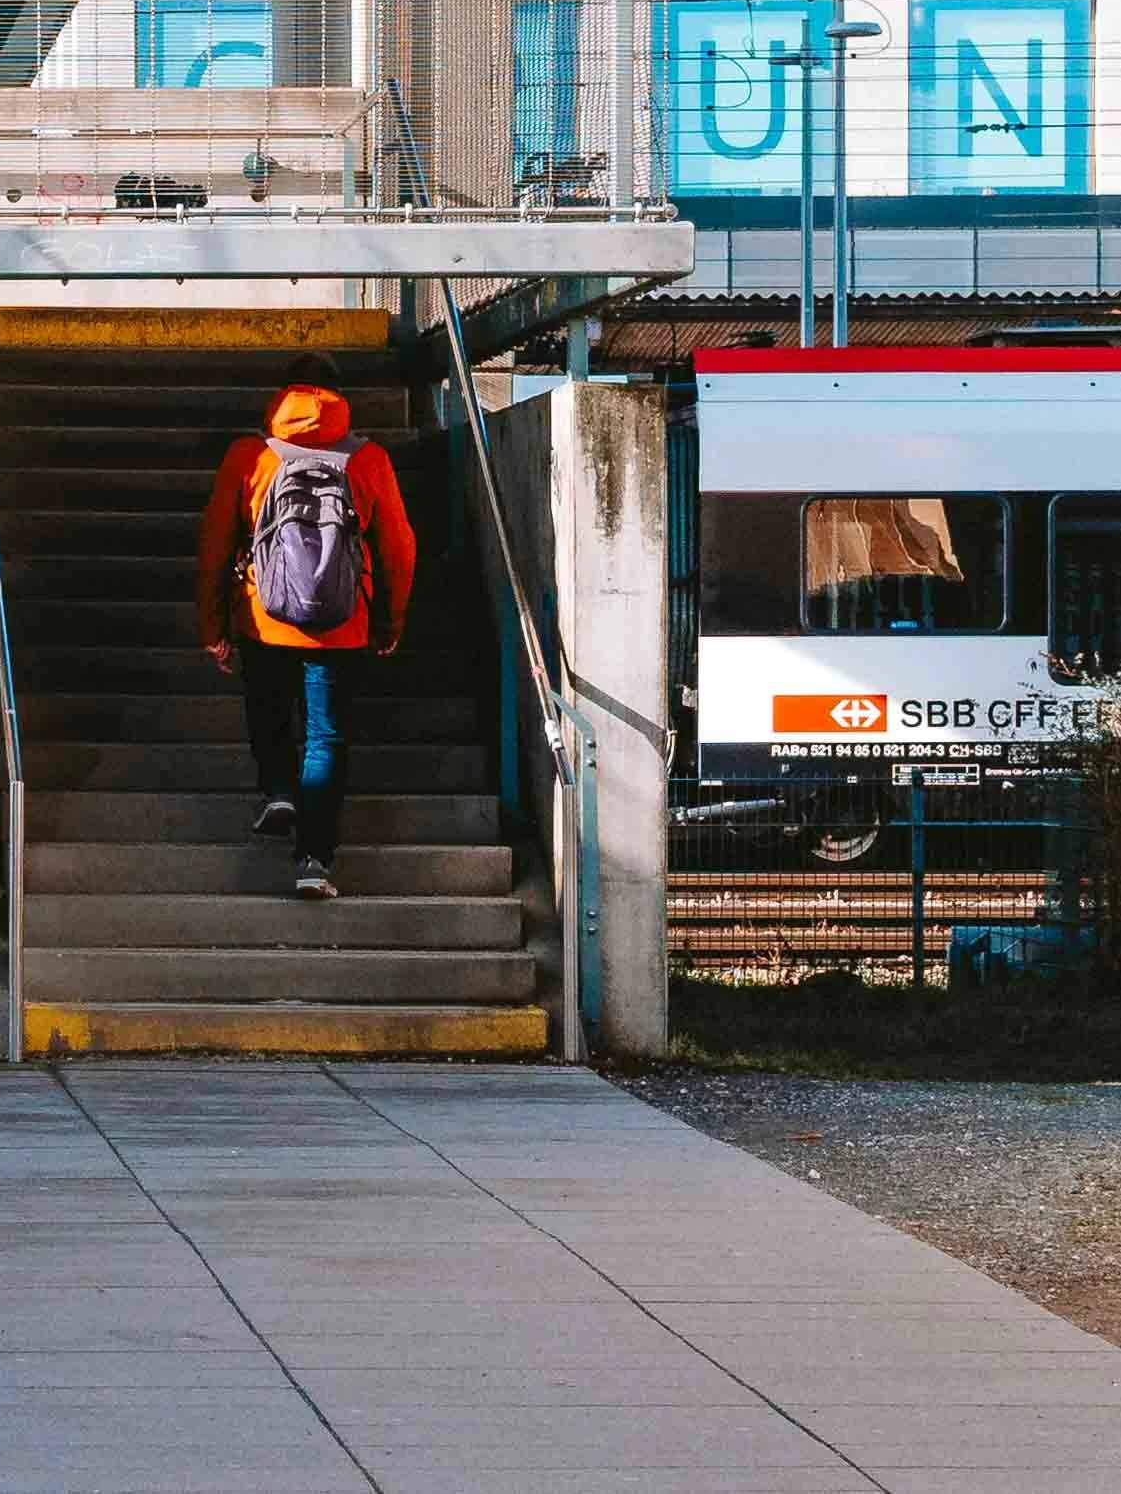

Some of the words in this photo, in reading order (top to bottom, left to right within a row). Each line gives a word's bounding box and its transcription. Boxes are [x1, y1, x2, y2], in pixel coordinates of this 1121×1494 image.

[700, 39, 785, 160] U
[957, 38, 1042, 157] N
[900, 699, 976, 728] SBB
[987, 699, 1058, 728] CFF
[771, 744, 808, 757] RABe
[810, 744, 832, 757] 521
[836, 744, 852, 757] 94
[854, 744, 870, 757] 85
[872, 744, 882, 757] 0
[883, 744, 906, 757] 521
[909, 744, 945, 757] 204-3
